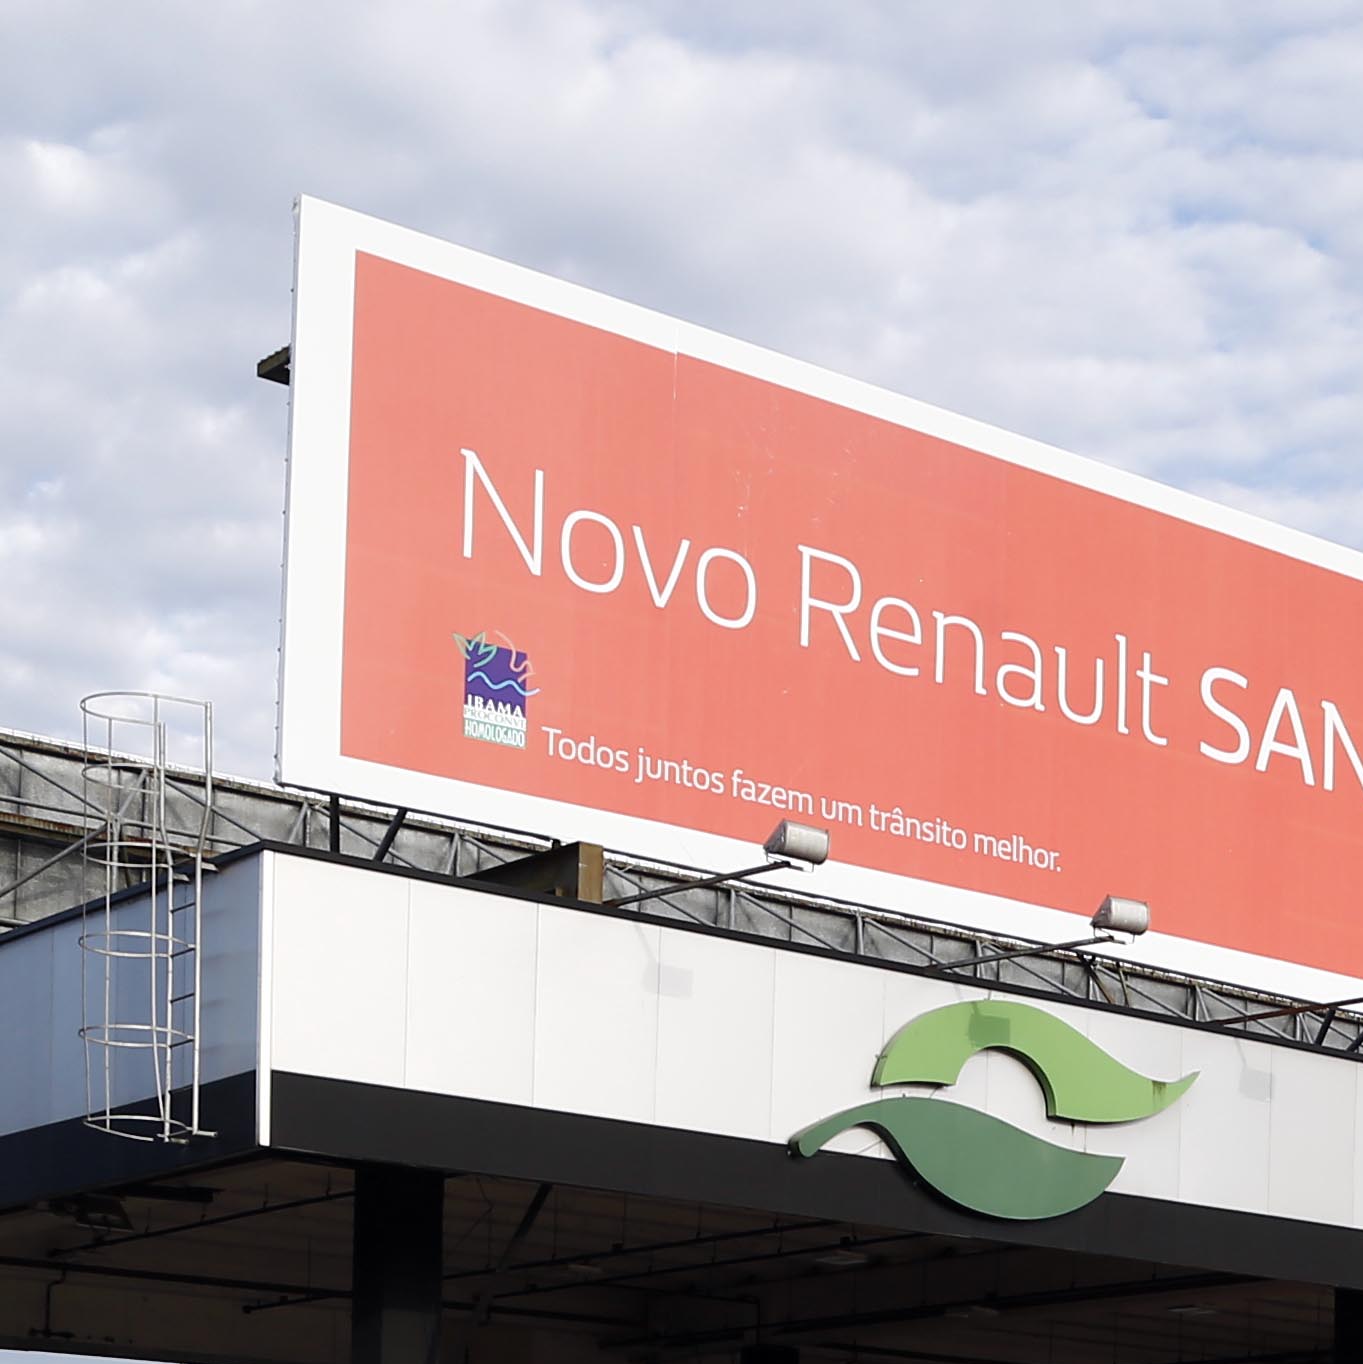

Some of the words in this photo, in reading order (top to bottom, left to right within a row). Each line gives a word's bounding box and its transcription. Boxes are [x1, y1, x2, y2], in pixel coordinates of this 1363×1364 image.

[460, 448, 758, 629] Novo
[796, 544, 1169, 746] Renault
[467, 694, 523, 718] IBAMA
[541, 726, 629, 772] Todos
[634, 747, 725, 794] juntos
[731, 769, 814, 815] fazem
[820, 797, 863, 827] um
[869, 804, 967, 850] trânsito
[974, 832, 1062, 872] melhor.
